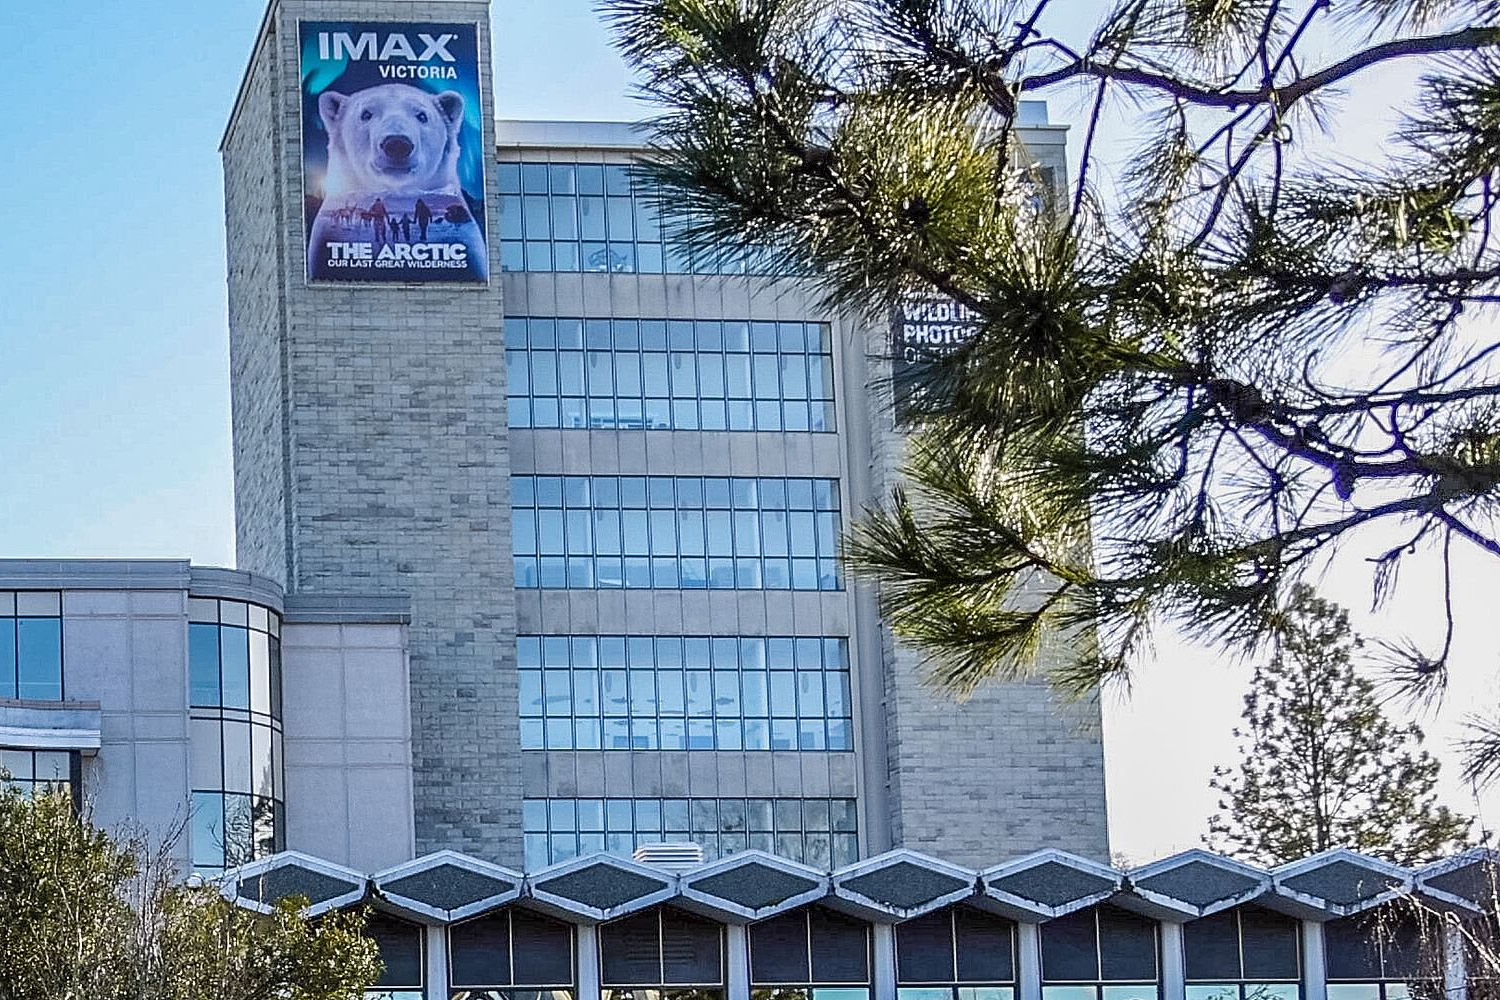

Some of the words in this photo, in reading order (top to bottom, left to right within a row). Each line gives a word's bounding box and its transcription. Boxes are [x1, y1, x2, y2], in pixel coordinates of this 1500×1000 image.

[319, 32, 457, 61] IMAX
[379, 65, 457, 79] VICTORIA
[327, 242, 372, 259] THE
[377, 243, 467, 260] ARCTIC
[328, 259, 348, 268] OUR
[350, 259, 373, 268] LAST
[375, 260, 405, 268] GREAT
[408, 260, 468, 268] WILDERNESS
